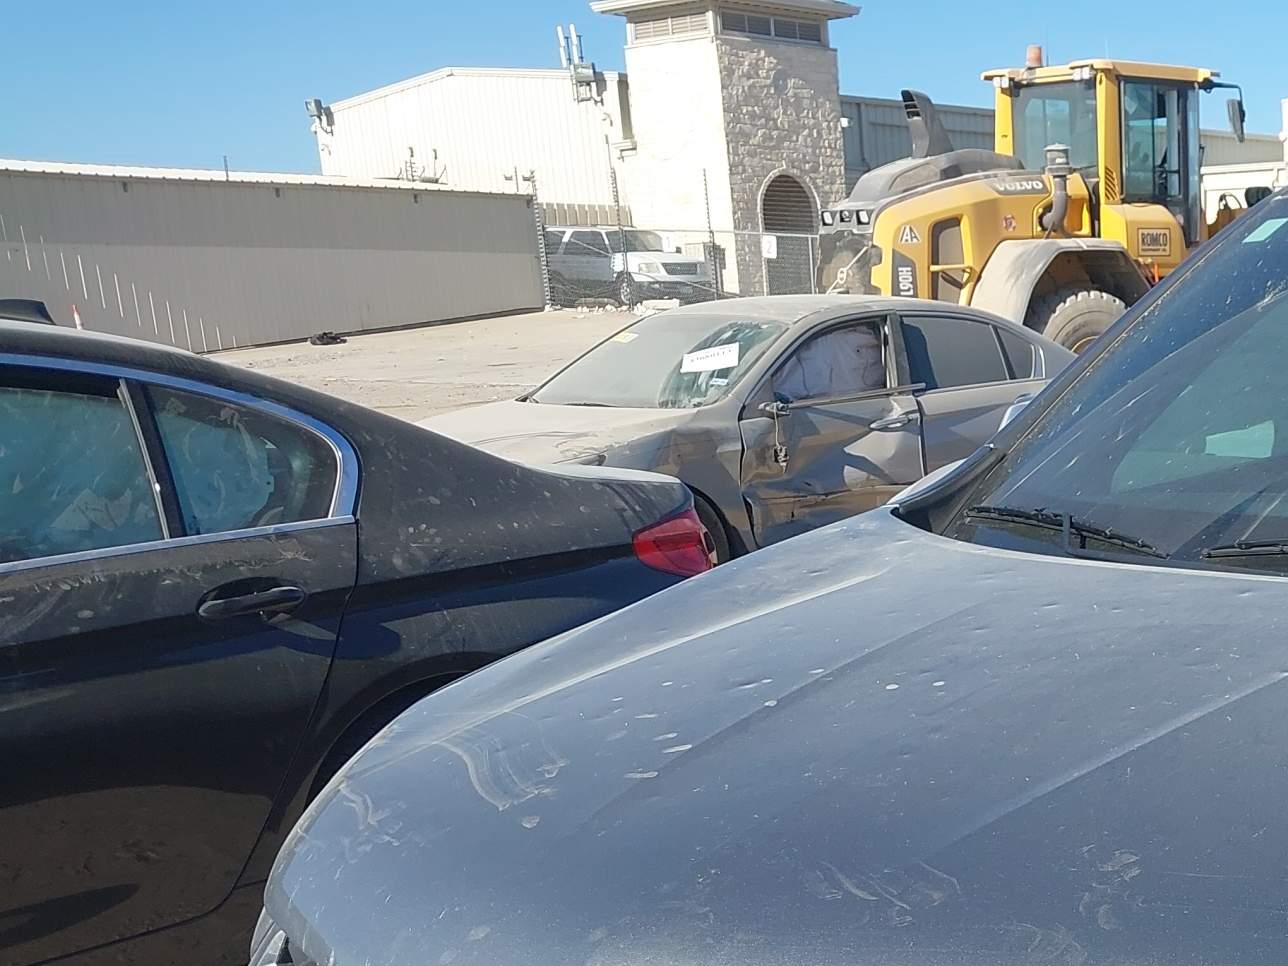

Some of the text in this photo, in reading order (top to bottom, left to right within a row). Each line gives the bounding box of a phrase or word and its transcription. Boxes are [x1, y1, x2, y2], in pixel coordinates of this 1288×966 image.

[995, 180, 1043, 191] VOLVO
[1141, 232, 1168, 247] ROMCO
[897, 266, 914, 297] L90H
